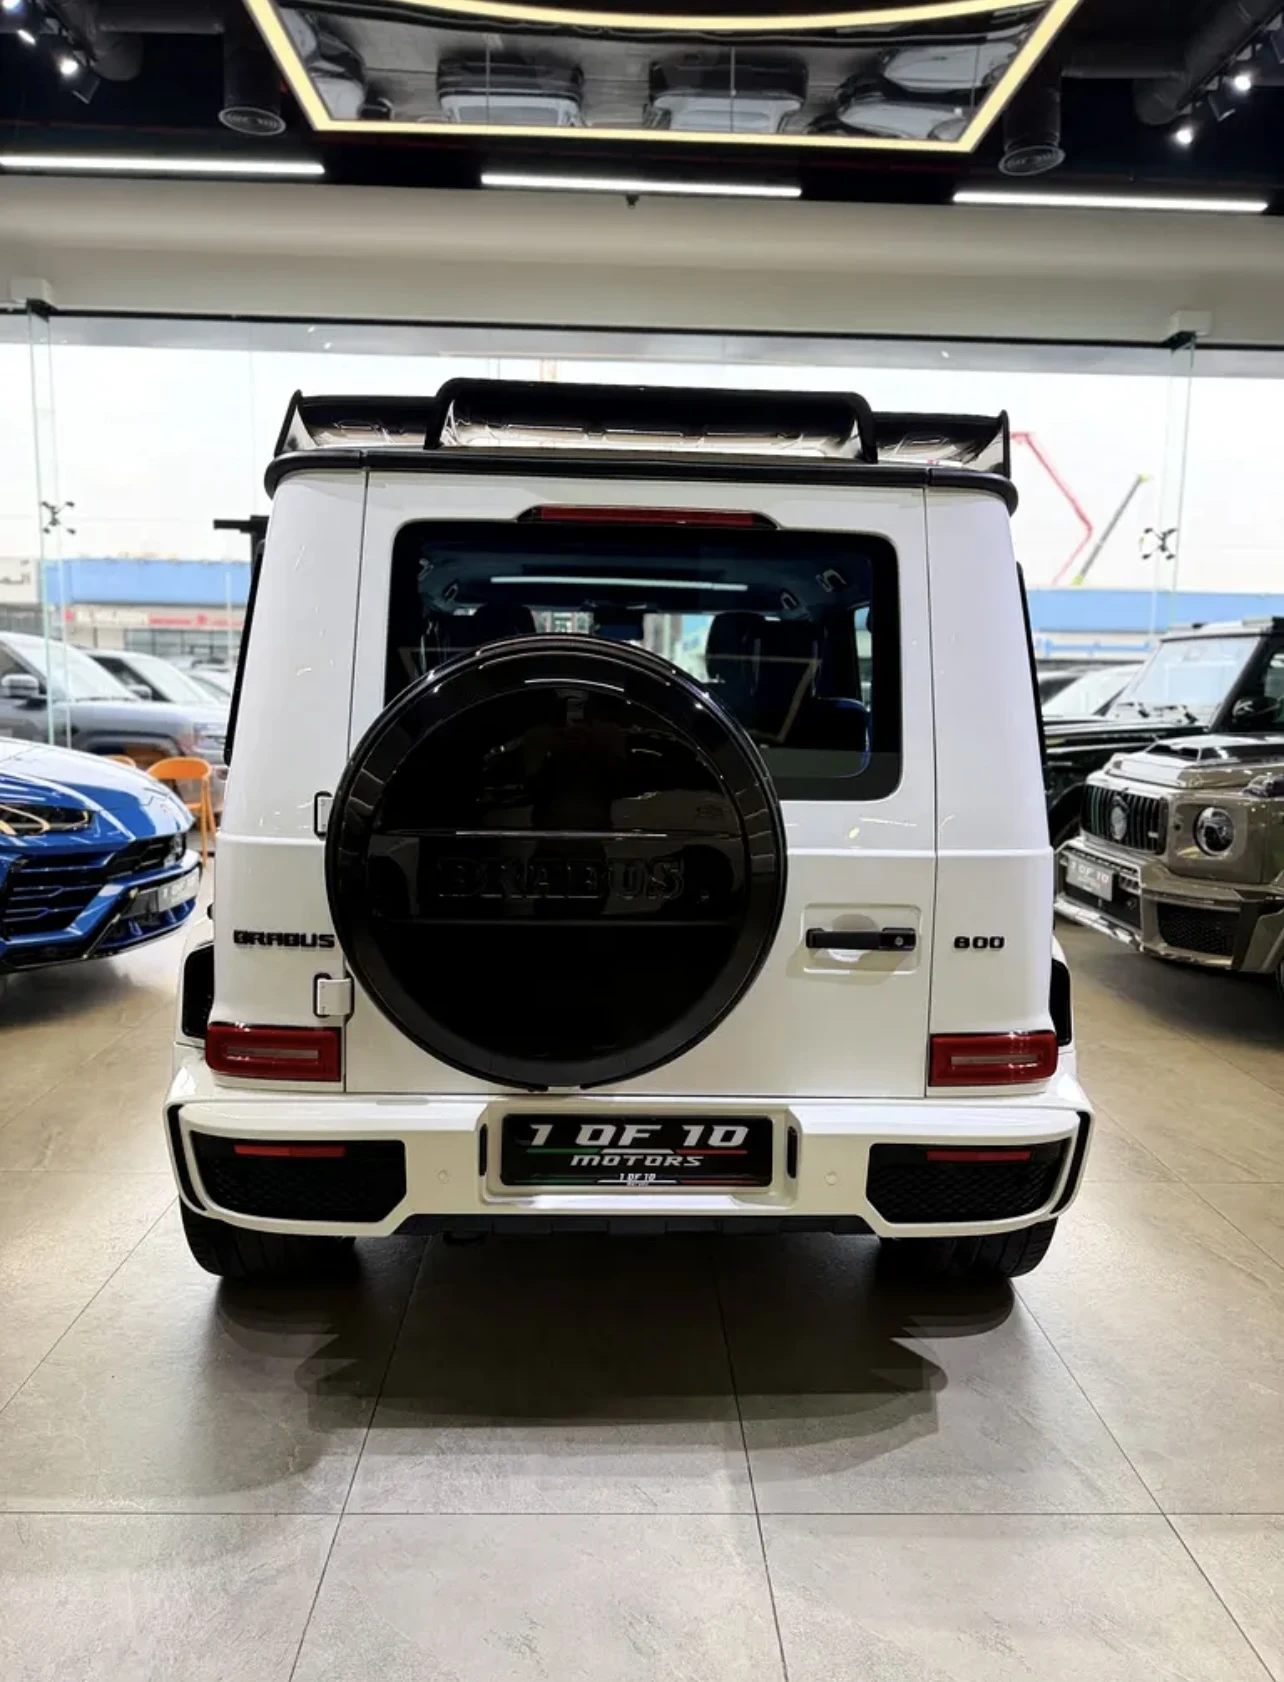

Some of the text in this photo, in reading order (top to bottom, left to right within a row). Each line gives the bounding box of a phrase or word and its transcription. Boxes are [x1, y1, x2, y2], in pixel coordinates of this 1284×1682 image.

[233, 929, 335, 949] BRABUS
[954, 936, 1005, 949] 800
[529, 1123, 750, 1148] 1 OF 10
[570, 1154, 704, 1168] MOTORS
